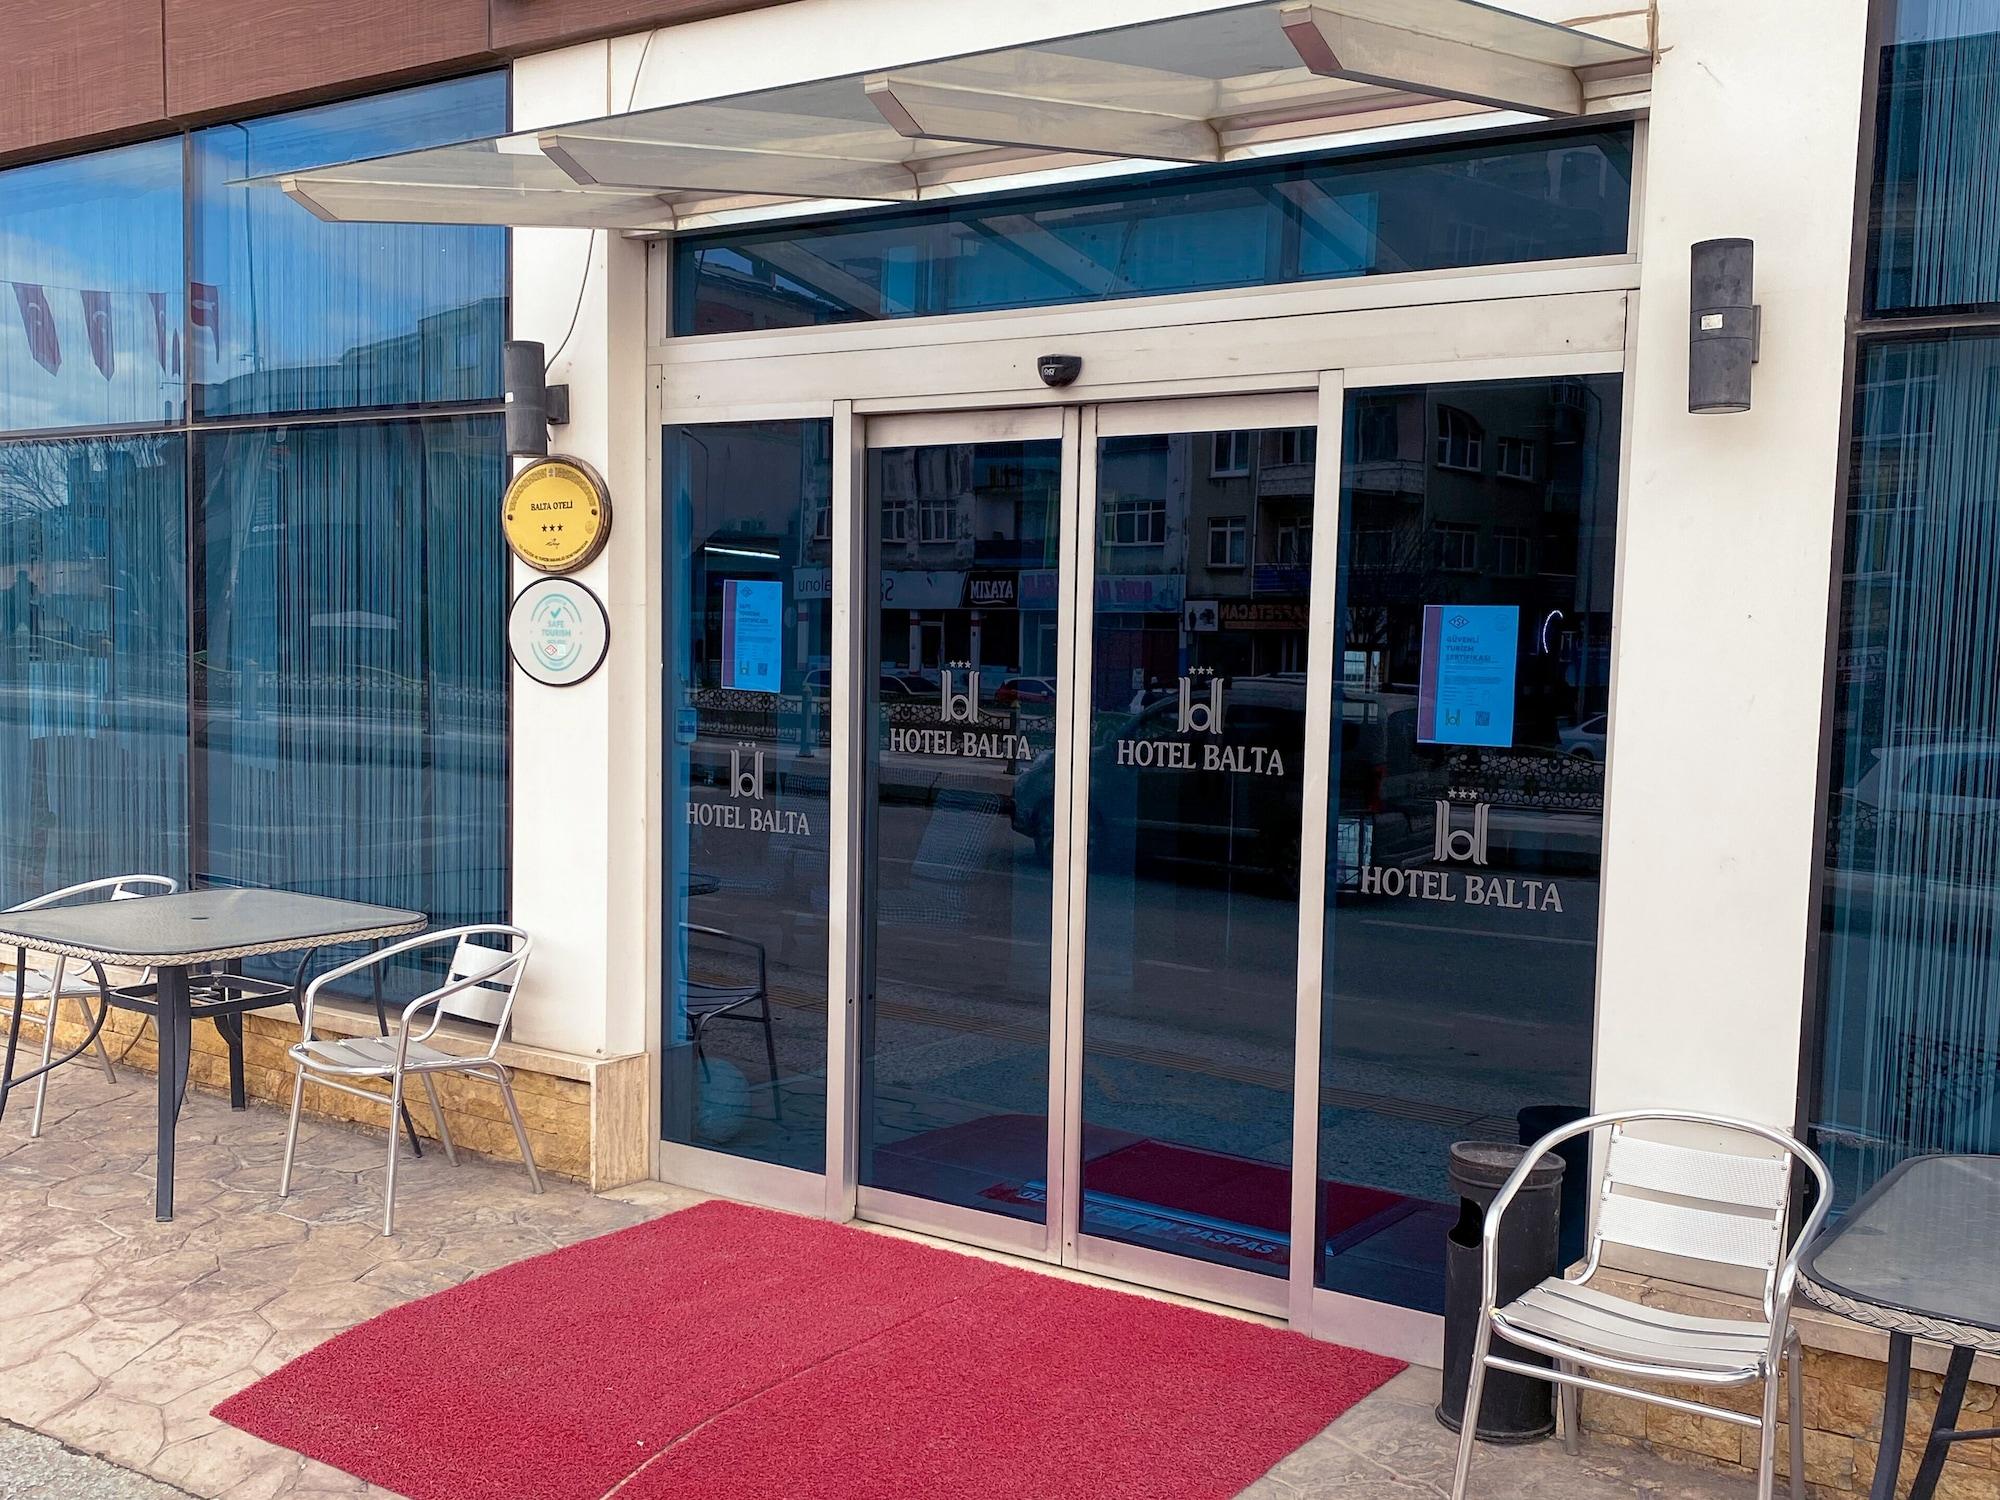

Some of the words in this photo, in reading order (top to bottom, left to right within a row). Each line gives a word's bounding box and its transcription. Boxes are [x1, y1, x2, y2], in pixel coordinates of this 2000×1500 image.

[530, 502, 552, 511] BALTA
[541, 629, 571, 637] TOURISM
[889, 728, 959, 756] HOTEL
[963, 732, 1031, 760] BALTA
[1117, 739, 1196, 770] HOTEL
[1202, 744, 1284, 777] BALTA
[685, 801, 746, 831] HOTEL
[749, 807, 811, 836] BALTA
[1361, 866, 1456, 902] HOTEL
[1465, 875, 1563, 913] BALTA
